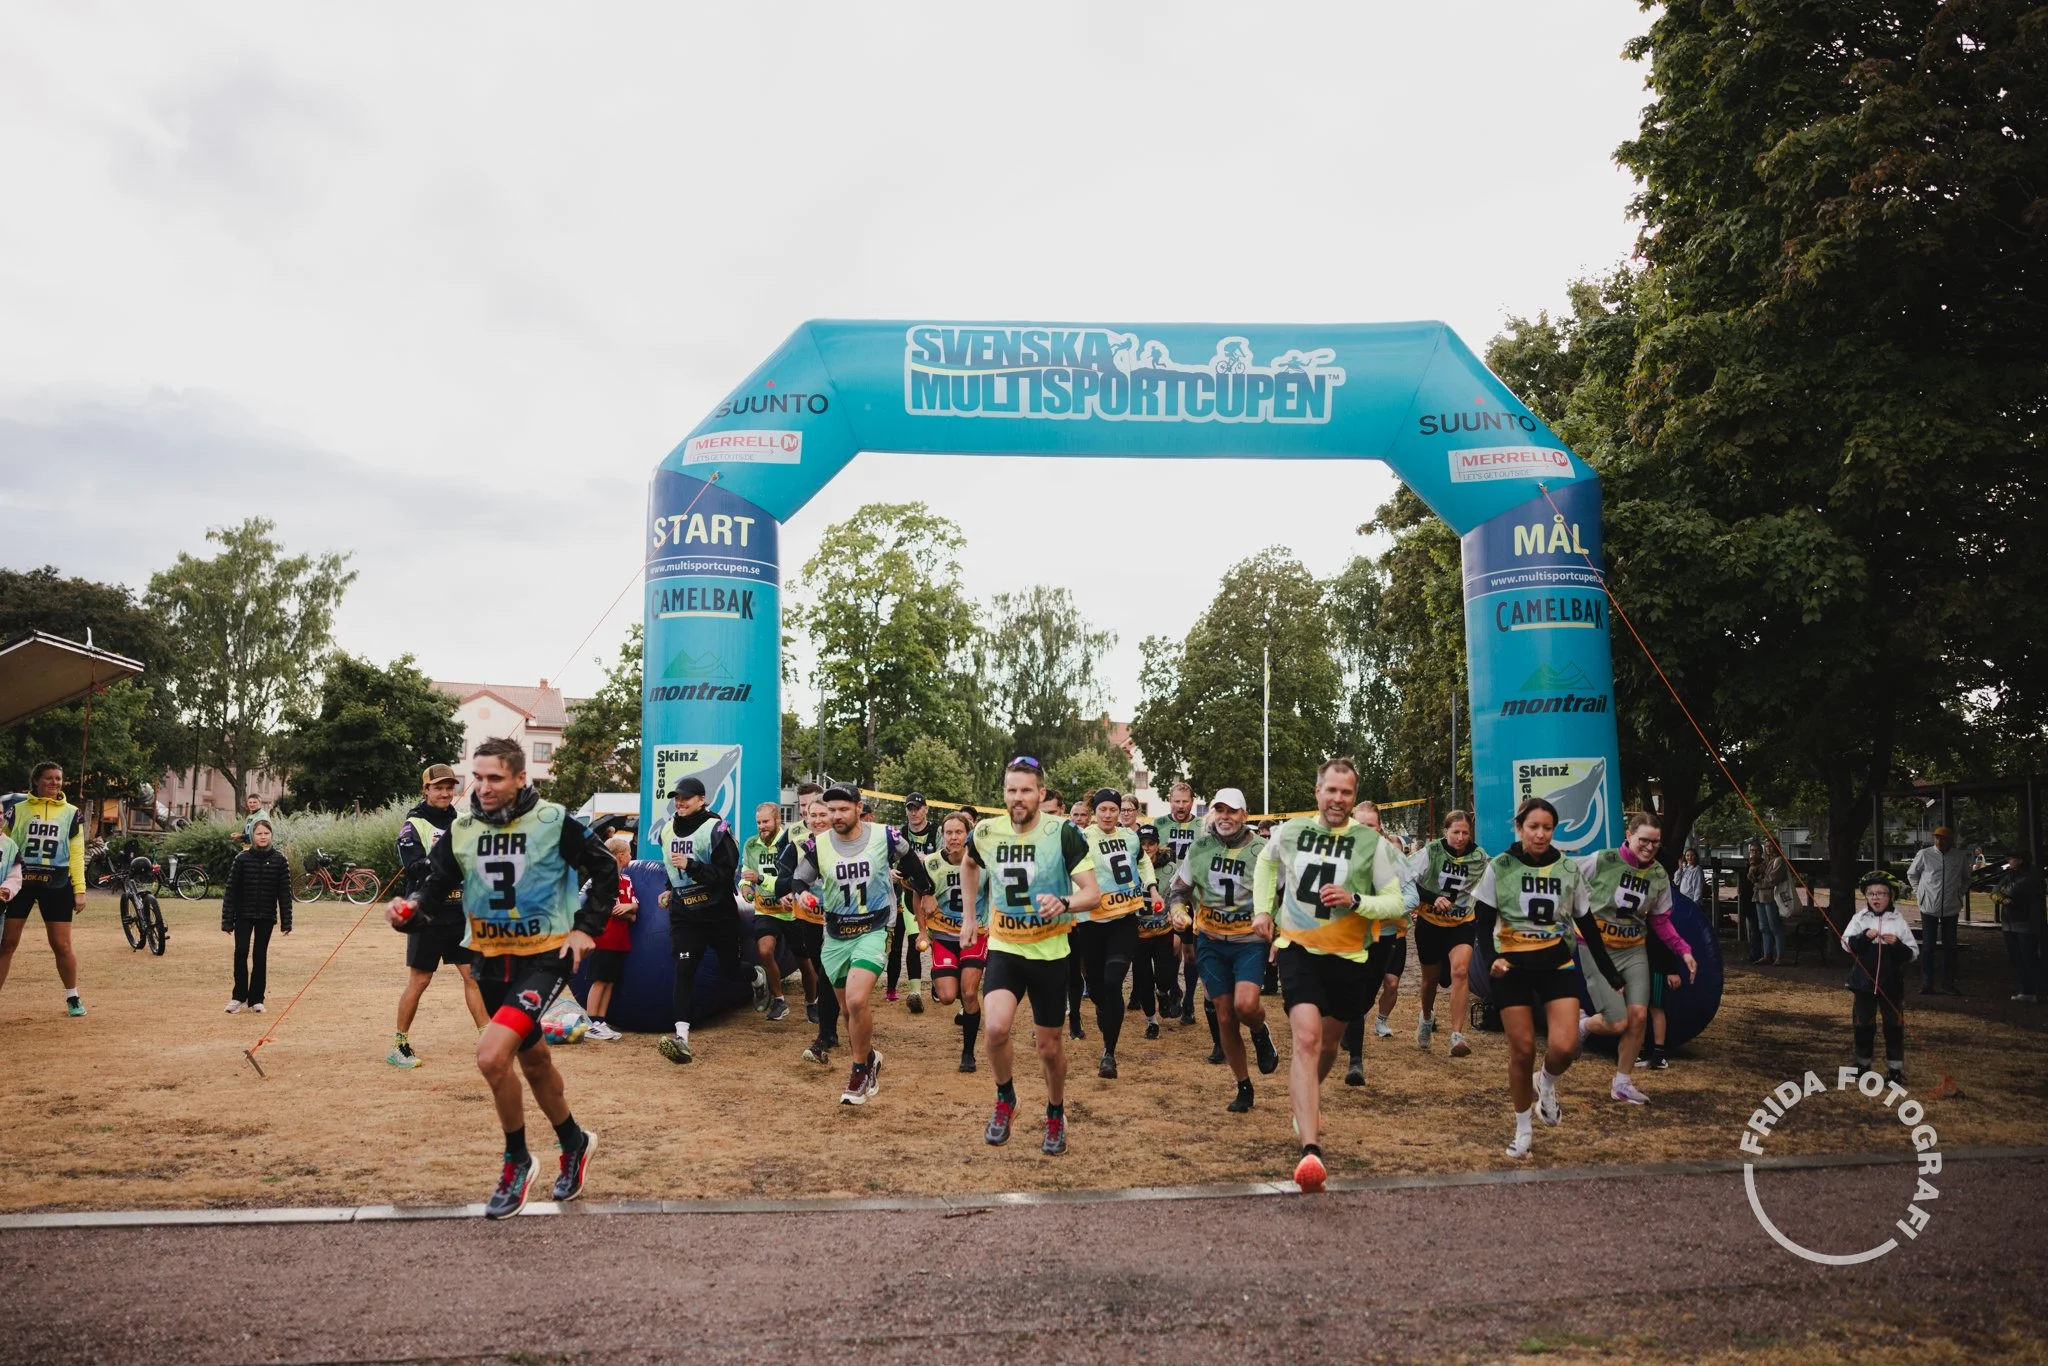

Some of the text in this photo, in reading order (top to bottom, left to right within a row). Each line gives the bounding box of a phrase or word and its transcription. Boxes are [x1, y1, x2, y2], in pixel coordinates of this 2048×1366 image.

[912, 329, 1109, 371] SVENSKA
[715, 393, 829, 418] SUUNTO
[911, 369, 1326, 419] MULTISPORTCUPEN
[1419, 411, 1536, 435] SUUNTO
[695, 436, 780, 450] MERRELL
[1462, 451, 1553, 467] MERRELL
[1484, 471, 1498, 479] GET
[1499, 469, 1530, 477] OUTSIDE
[653, 513, 755, 548] START
[1514, 513, 1589, 556] MÅL
[650, 561, 760, 575] www.multisportcupen.se
[651, 587, 754, 620] CAMELBAK
[1496, 596, 1604, 633] CAMELBAK
[649, 682, 753, 703] montrail
[1500, 694, 1608, 716] montrail
[656, 750, 698, 799] Seal Skinz
[1519, 765, 1569, 802] eal Skinz
[28, 820, 59, 837] ÖAR
[1169, 826, 1194, 840] ÖAR
[24, 837, 58, 859] 29
[477, 830, 526, 857] ÖAR
[671, 838, 693, 854] ÖAR
[996, 841, 1036, 863] ÖAR
[1099, 838, 1128, 855] ÖAR
[1297, 826, 1355, 861] ÖAR
[835, 861, 870, 880] ÖAR
[1110, 854, 1133, 885] 6
[1210, 853, 1246, 877] ÖAR
[484, 861, 516, 910] 3
[839, 881, 867, 907] 11
[1003, 867, 1032, 907] 2
[1219, 878, 1235, 906] 1
[1296, 862, 1337, 920] 4
[1521, 872, 1562, 896] ÖAR
[1620, 870, 1651, 895] ÖAR
[1615, 893, 1641, 919] 2
[476, 919, 541, 939] JOKAB
